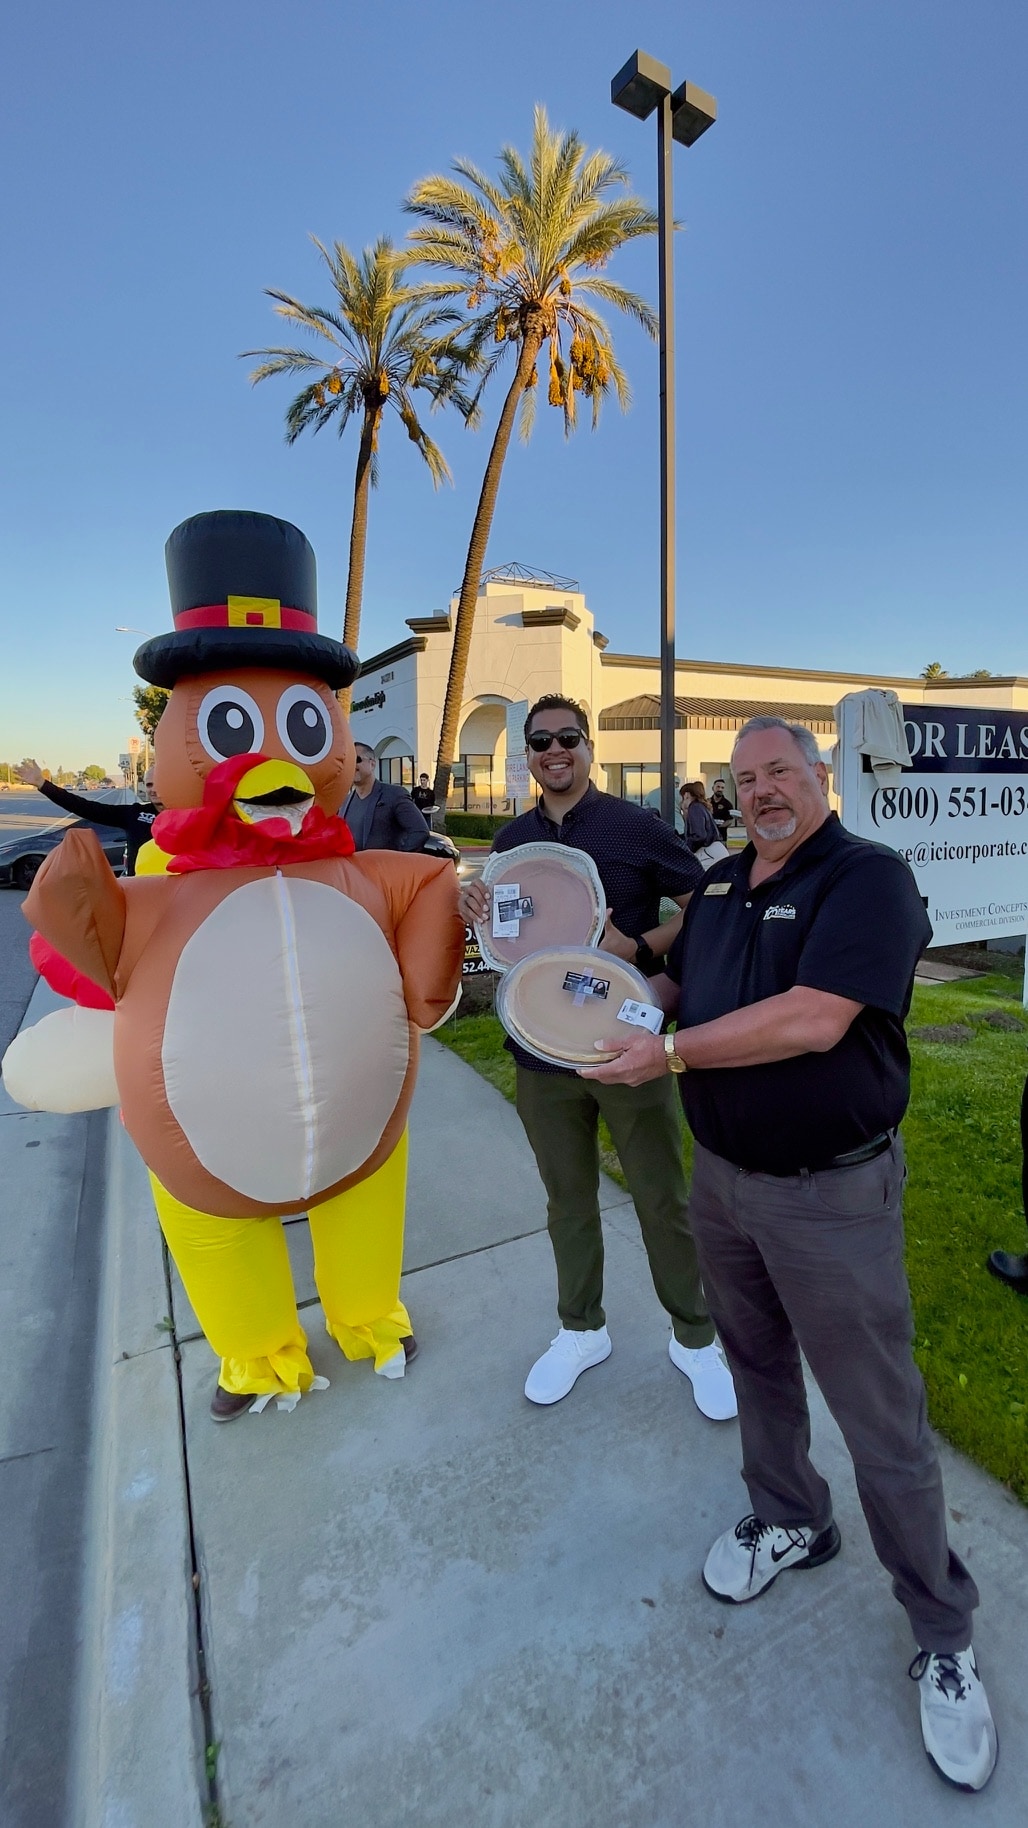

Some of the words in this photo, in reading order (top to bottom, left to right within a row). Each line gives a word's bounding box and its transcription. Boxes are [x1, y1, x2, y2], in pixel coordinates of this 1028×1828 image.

[903, 721, 948, 758] OR
[870, 786, 939, 827] (800)
[948, 786, 1028, 818] 551-03
[898, 840, 1028, 867] se@icicorporate.c
[955, 918, 998, 930] COMMERCIAL
[998, 915, 1025, 925] DIVISION
